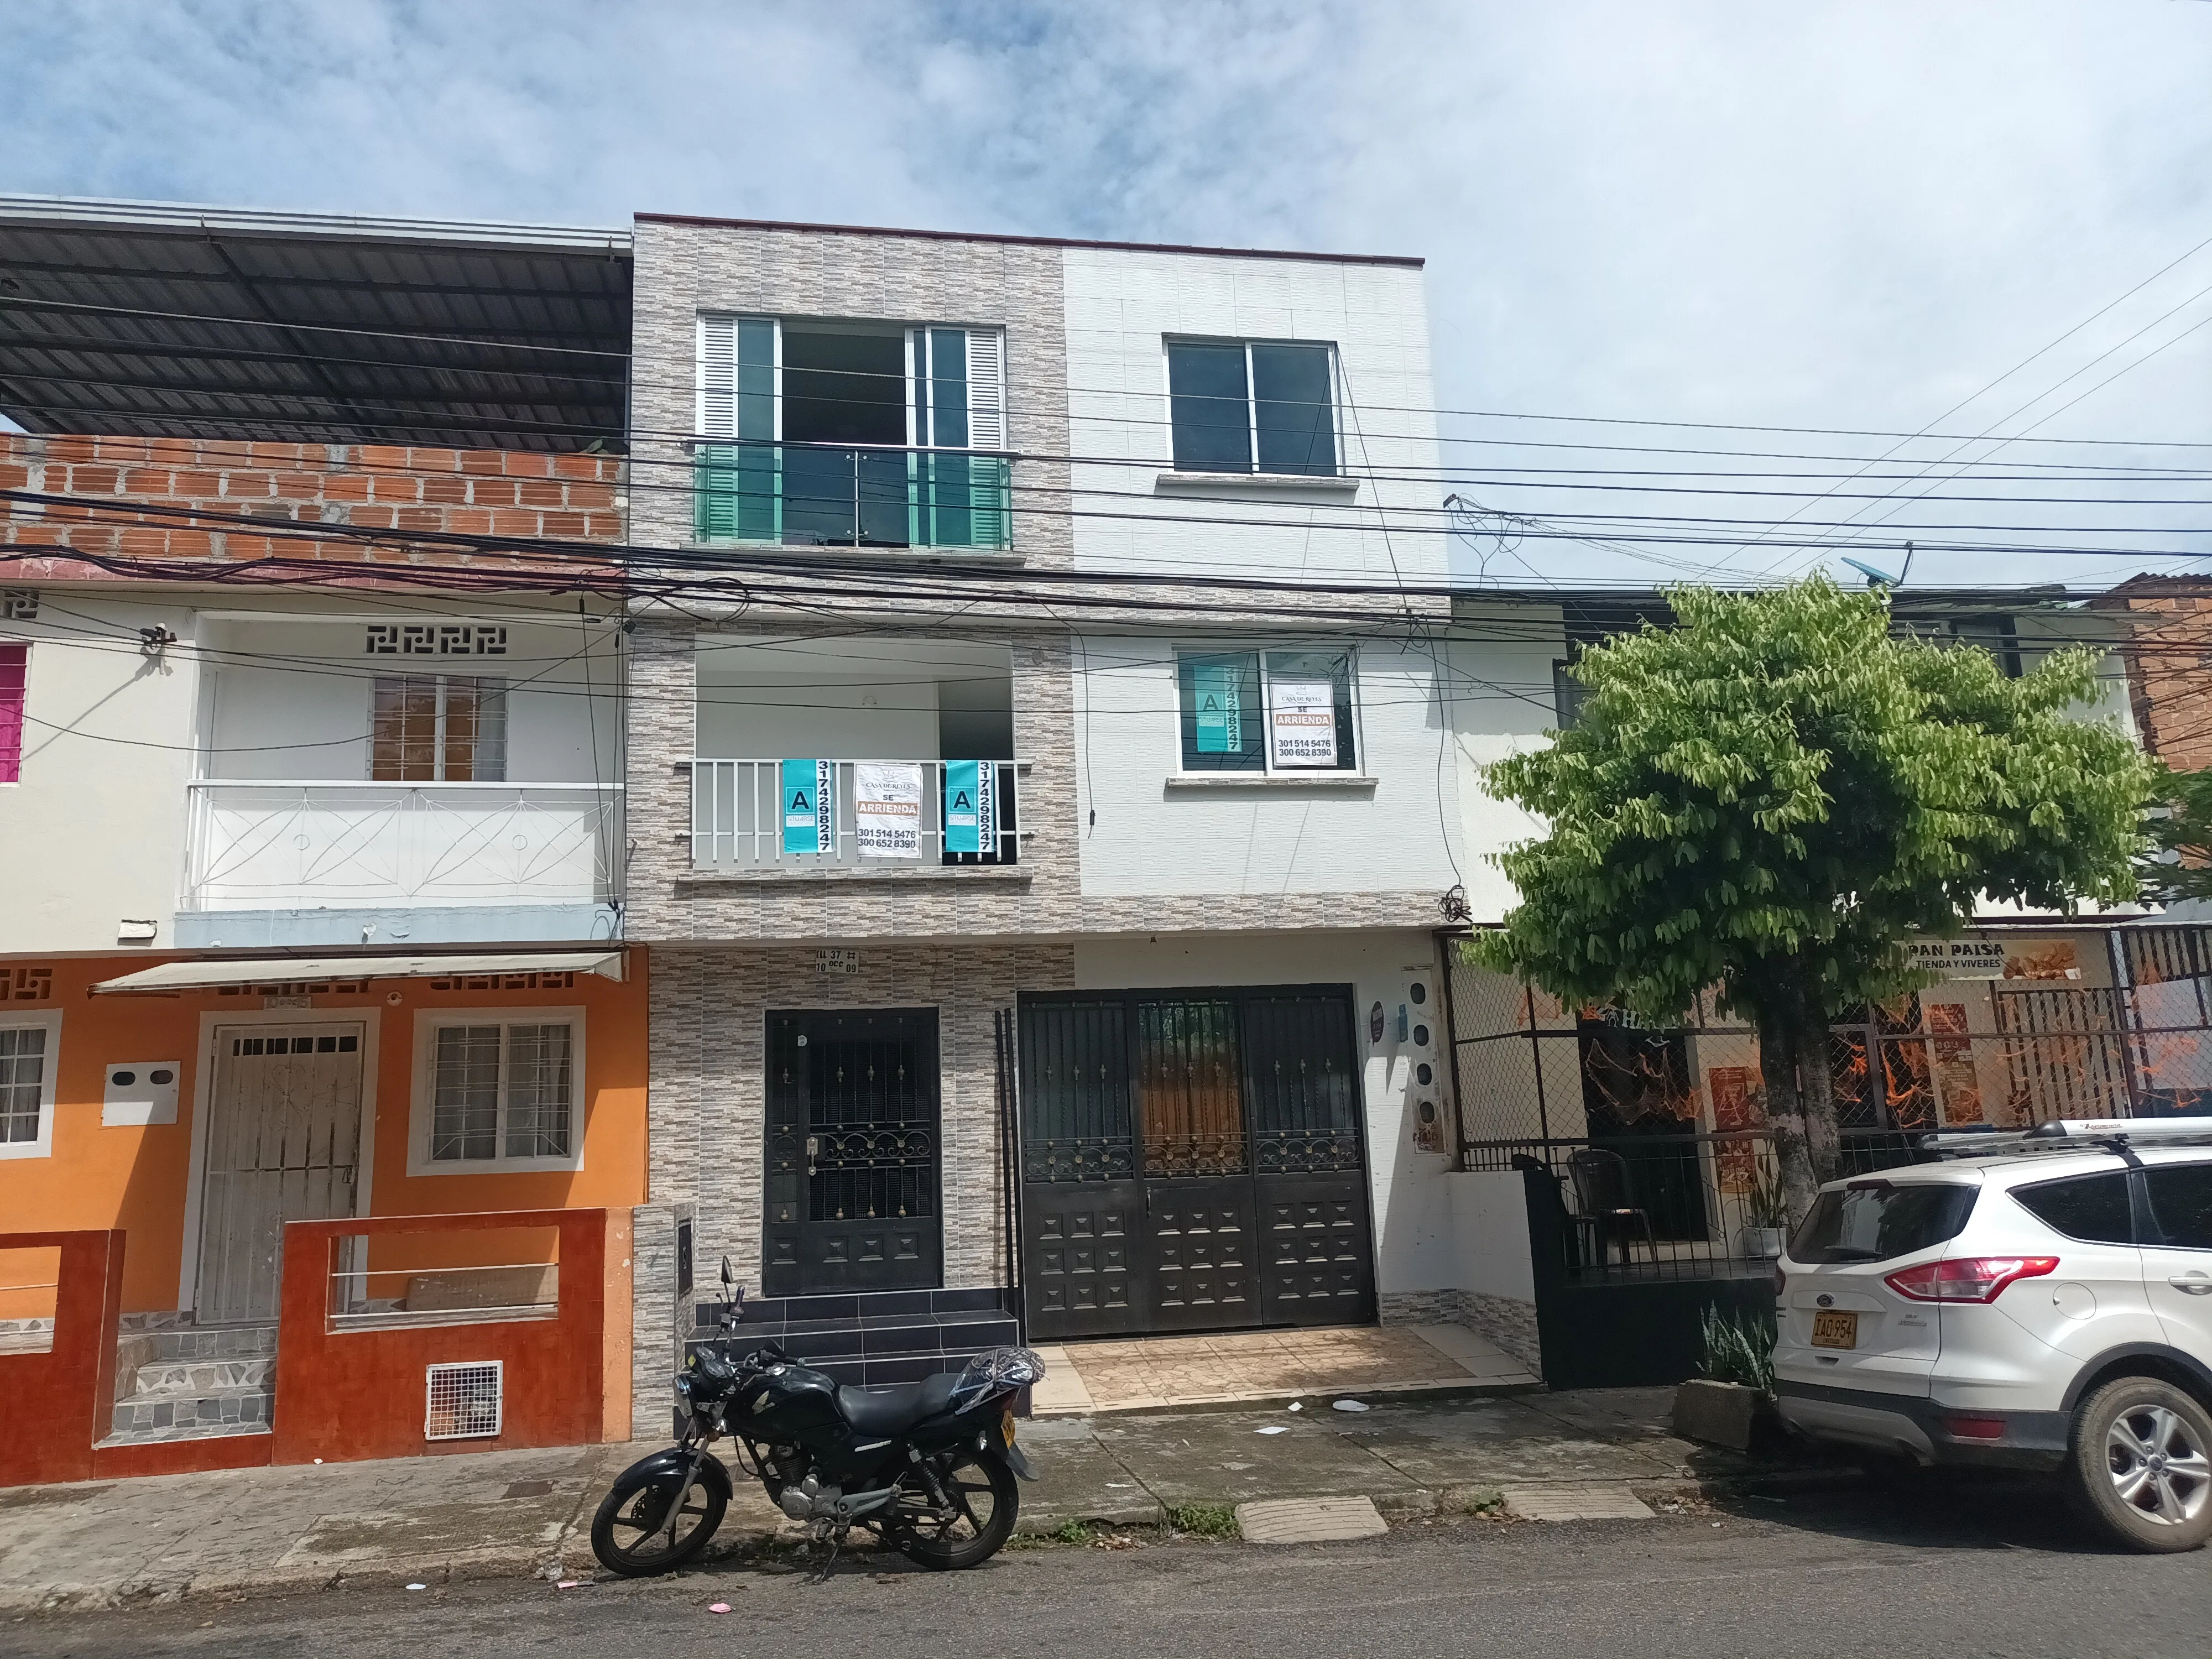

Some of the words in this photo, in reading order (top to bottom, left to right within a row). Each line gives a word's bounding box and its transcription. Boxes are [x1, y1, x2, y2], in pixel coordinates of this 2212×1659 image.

[1203, 694, 1219, 711] A
[1277, 716, 1329, 724] ARRIENDA
[1311, 739, 1331, 748] 5476
[791, 791, 810, 810] A
[953, 791, 971, 808] A
[818, 760, 830, 851] 3174298247
[859, 803, 916, 814] ARRIENDA
[980, 762, 990, 851] 3174298247
[858, 828, 874, 837] 301
[876, 830, 893, 838] 514
[894, 831, 916, 839] 5476
[858, 838, 874, 847] 300
[876, 839, 893, 848] 652
[894, 840, 916, 848] 8390
[831, 950, 841, 959] 37
[1907, 945, 1944, 956] PAN
[1950, 943, 2005, 956] PAISA
[816, 963, 826, 972] 10
[846, 964, 857, 973] 09
[1916, 960, 1952, 968] TIENDA
[1961, 959, 2001, 968] VIVERES
